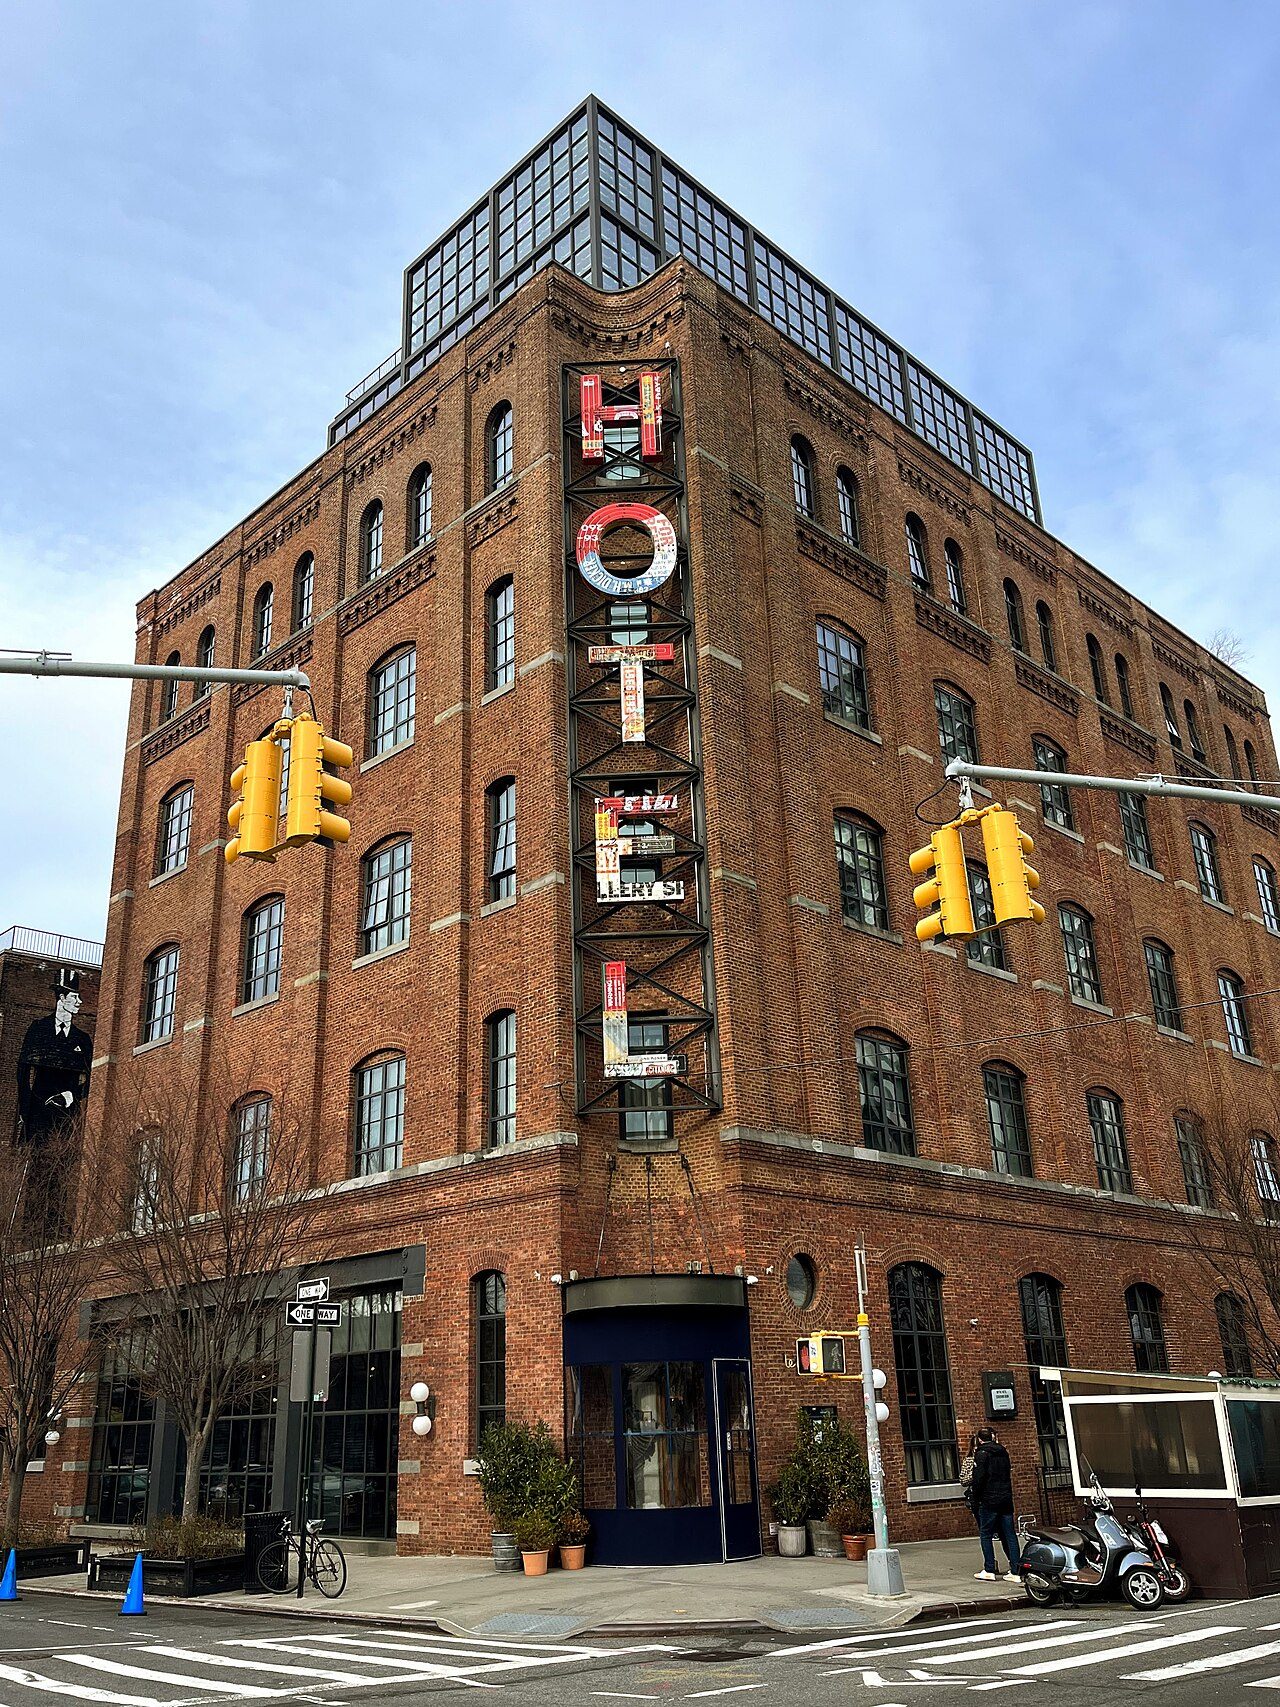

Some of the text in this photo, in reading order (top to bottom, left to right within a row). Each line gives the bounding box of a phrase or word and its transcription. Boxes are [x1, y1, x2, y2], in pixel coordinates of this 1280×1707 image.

[577, 372, 685, 1078] HOTEL
[606, 980, 614, 1007] WARNING
[295, 1309, 335, 1319] ONE WAY
